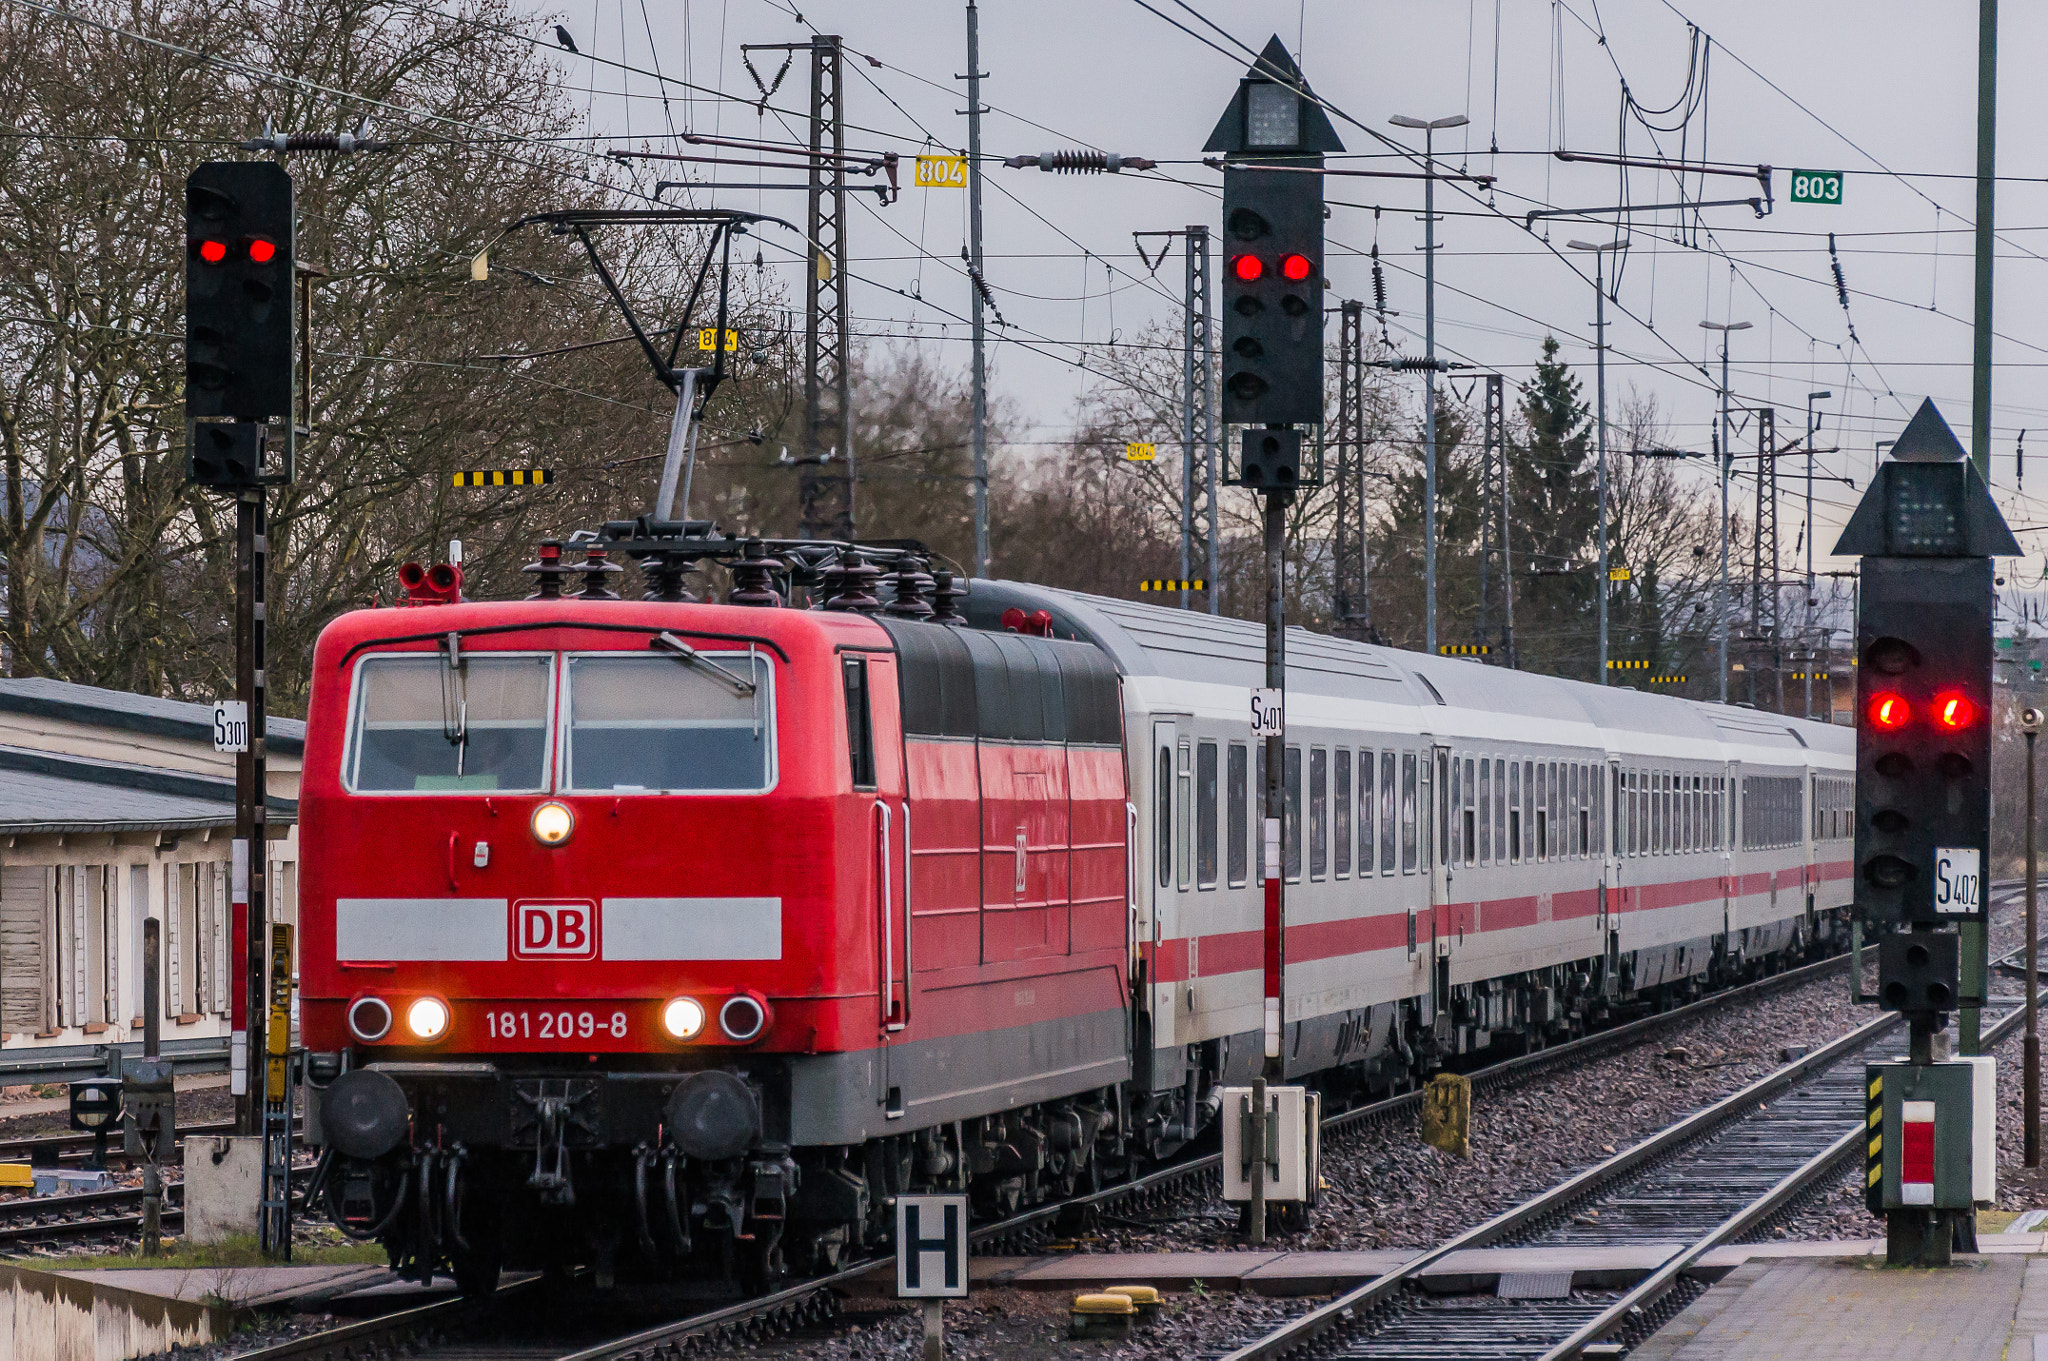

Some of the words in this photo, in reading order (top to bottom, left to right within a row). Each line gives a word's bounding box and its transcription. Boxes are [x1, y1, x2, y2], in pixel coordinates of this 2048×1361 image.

[919, 160, 963, 184] 804
[1795, 176, 1839, 200] 803
[524, 909, 586, 949] DB
[486, 1011, 530, 1038] 181
[538, 1011, 628, 1039] 209-8
[905, 1204, 959, 1289] H
